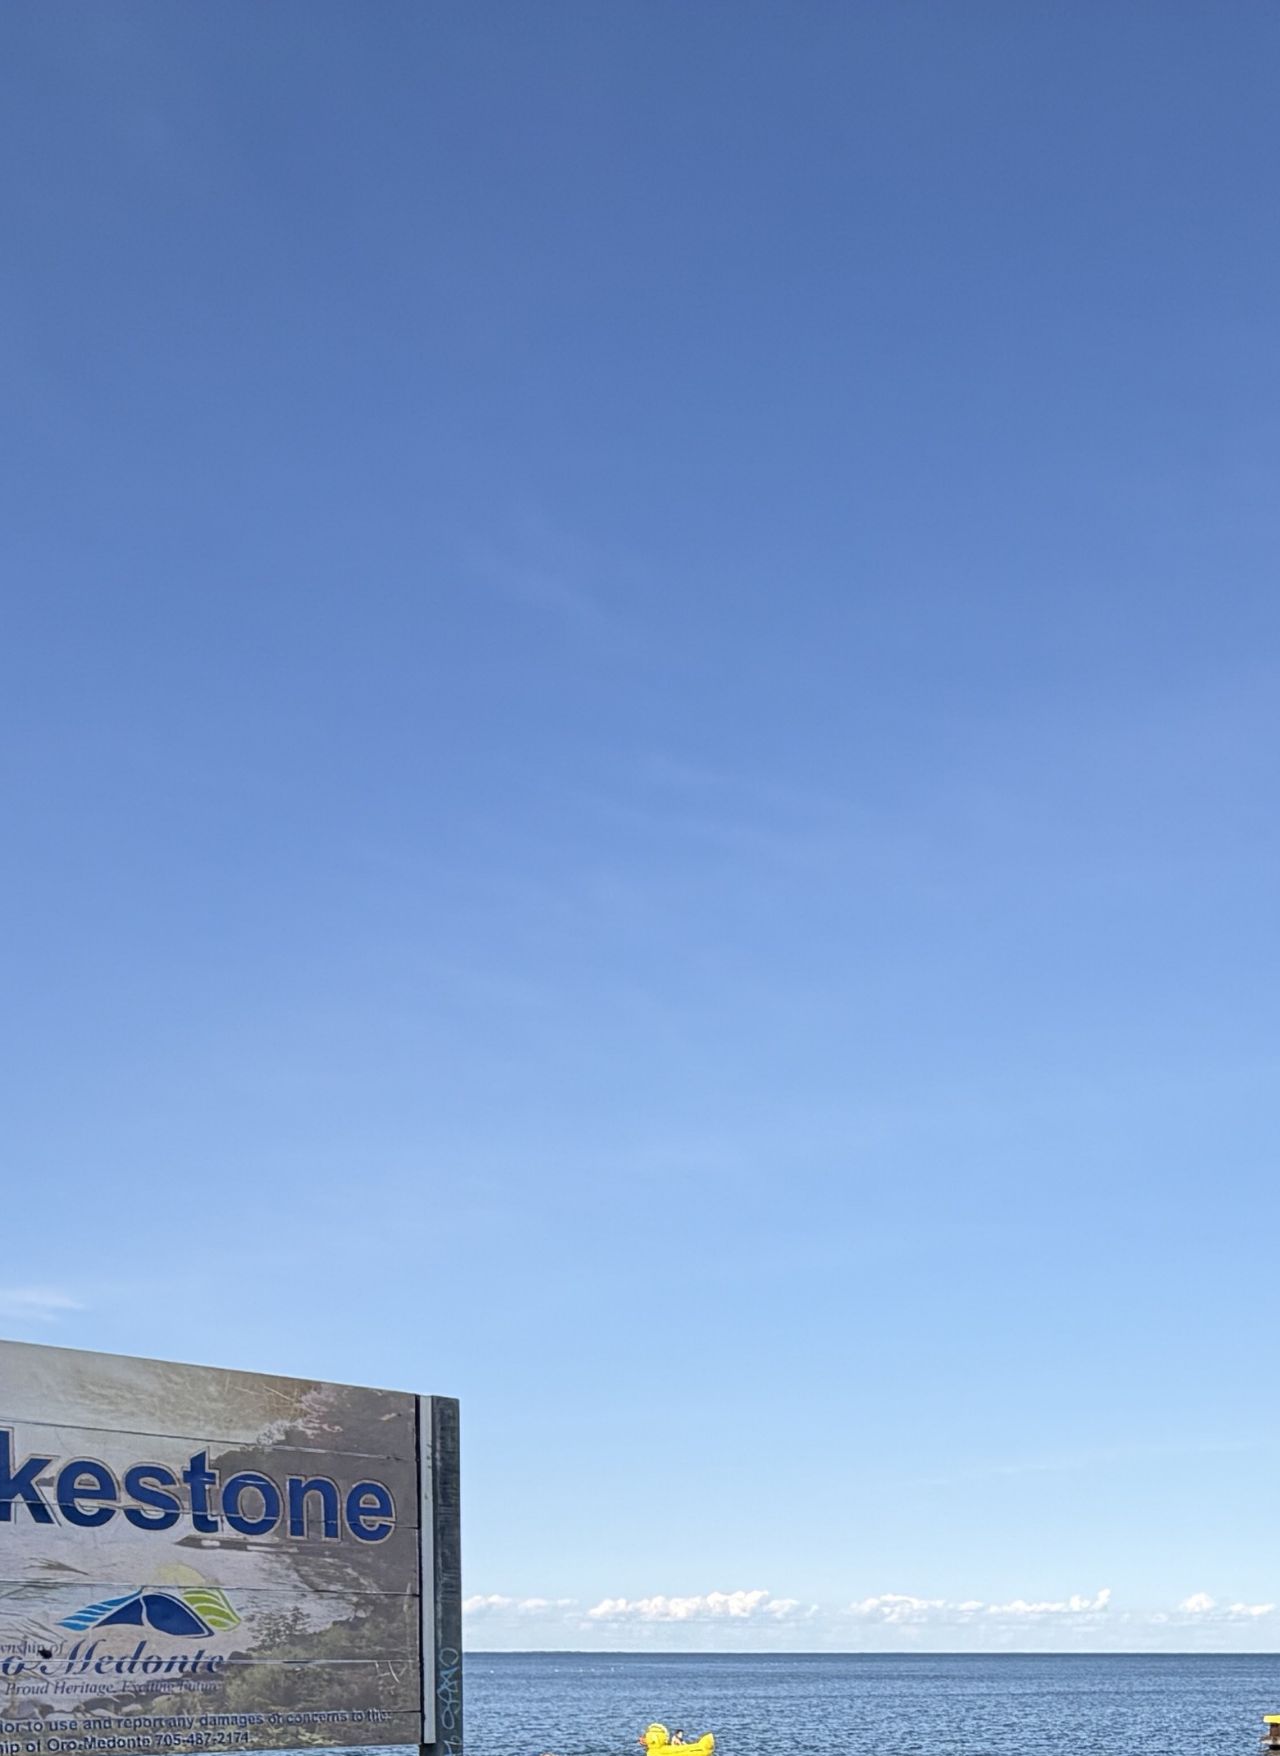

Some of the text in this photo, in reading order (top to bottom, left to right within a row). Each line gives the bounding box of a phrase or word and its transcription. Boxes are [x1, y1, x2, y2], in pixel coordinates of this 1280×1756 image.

[51, 1640, 65, 1656] of
[4, 1681, 50, 1696] Proud
[27, 1719, 44, 1733] to
[48, 1719, 78, 1732] use
[82, 1717, 112, 1731] and
[117, 1716, 163, 1732] report
[167, 1715, 194, 1730] any
[199, 1713, 265, 1729] damages
[286, 1710, 348, 1725] concerns
[351, 1709, 365, 1723] to
[154, 1731, 250, 1747] 705-487-2174
